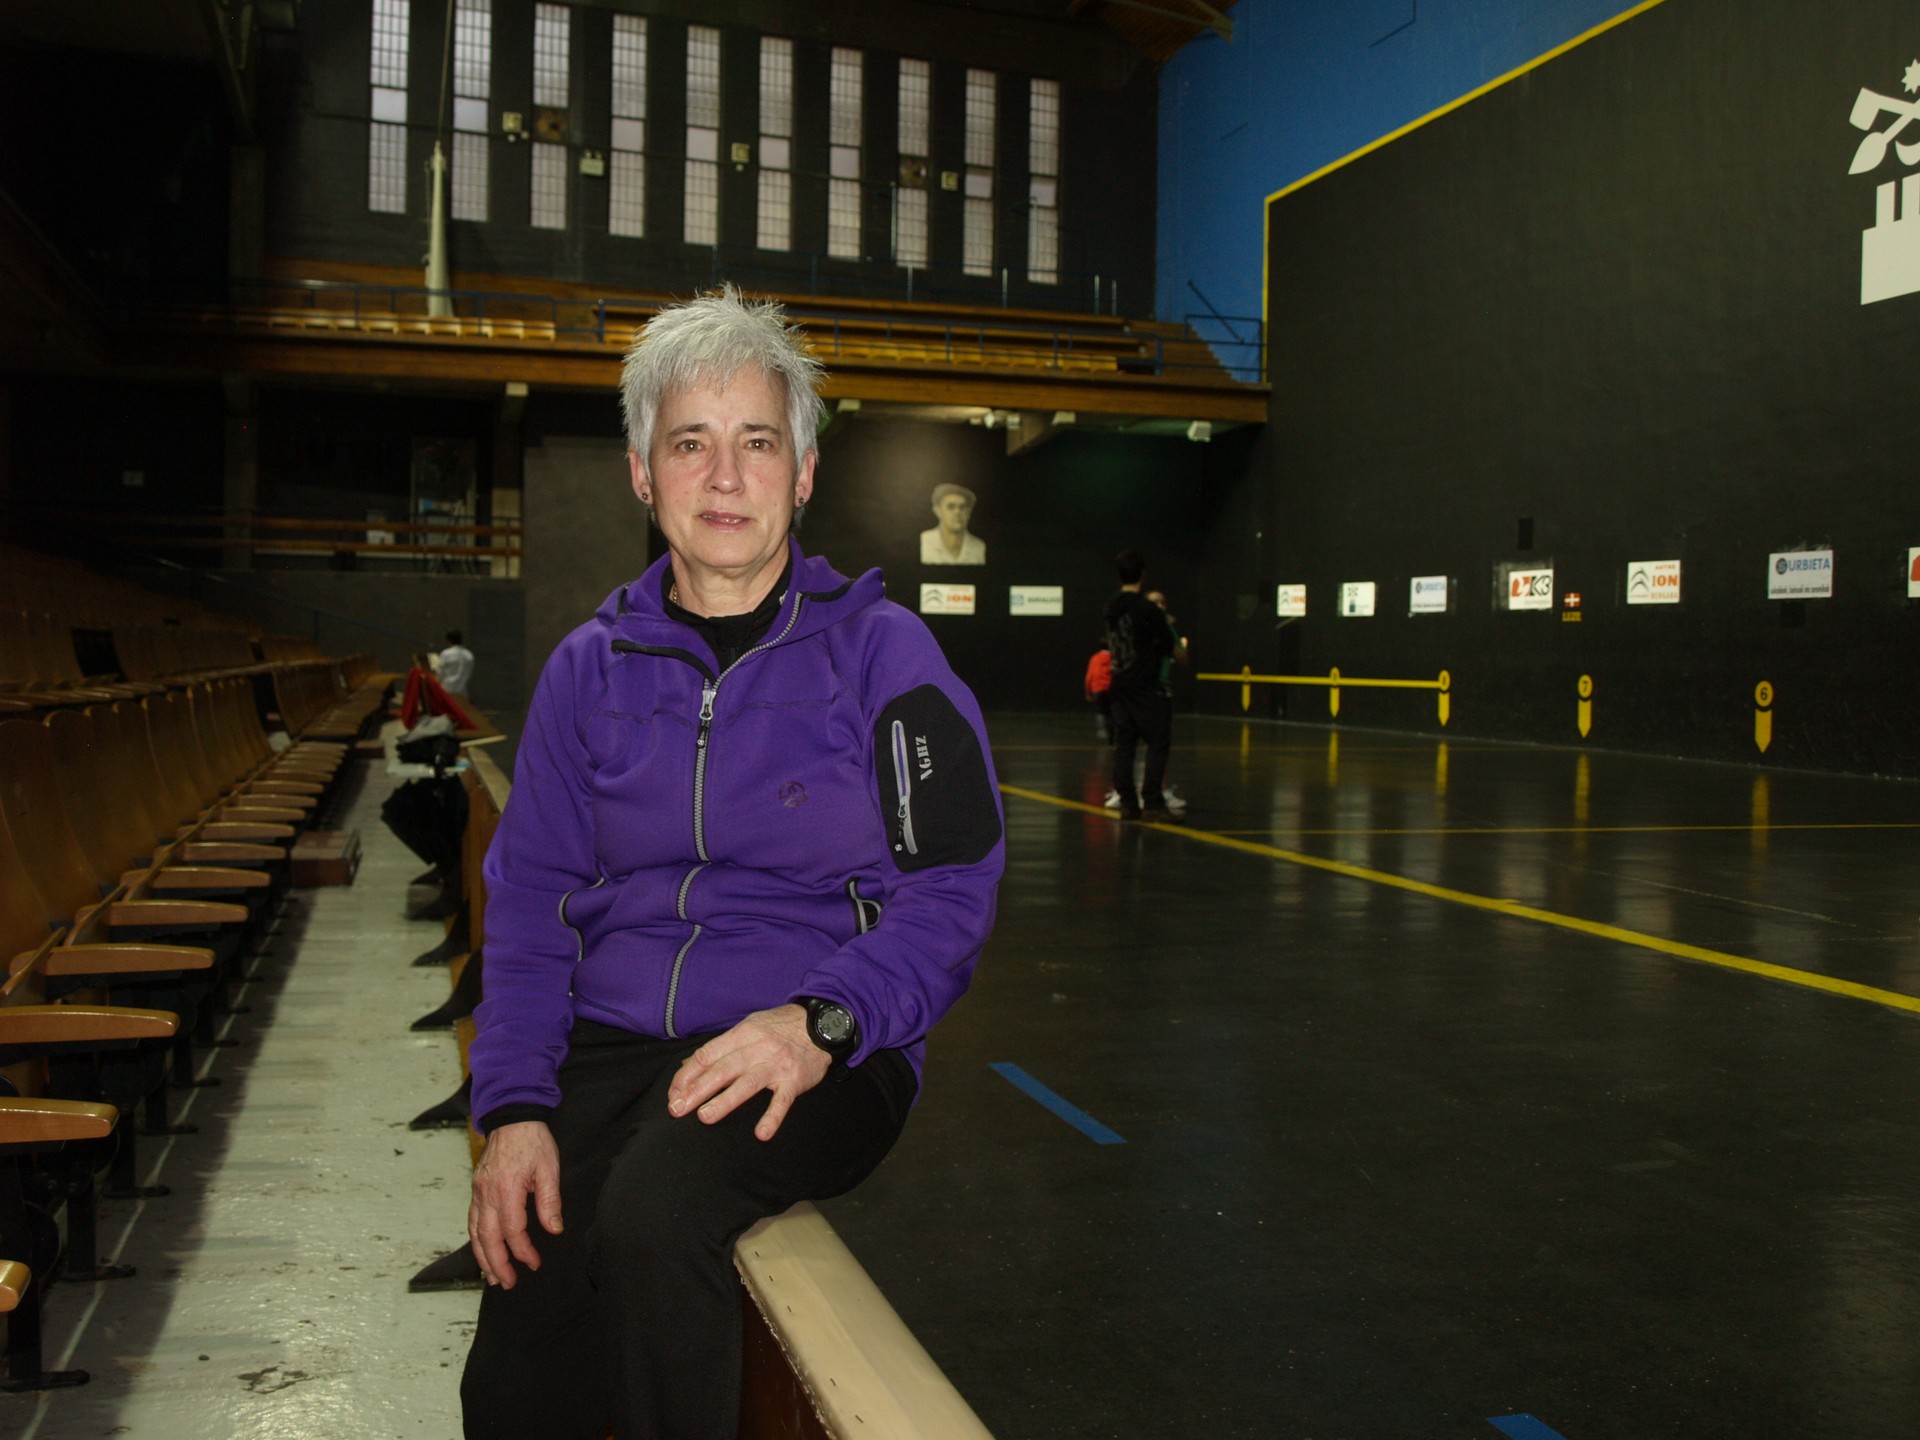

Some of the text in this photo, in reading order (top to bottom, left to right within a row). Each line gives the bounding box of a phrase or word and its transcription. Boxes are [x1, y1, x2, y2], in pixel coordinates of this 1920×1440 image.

[1788, 557, 1831, 571] URBIETA
[1652, 575, 1678, 587] ION
[1760, 687, 1768, 701] 6
